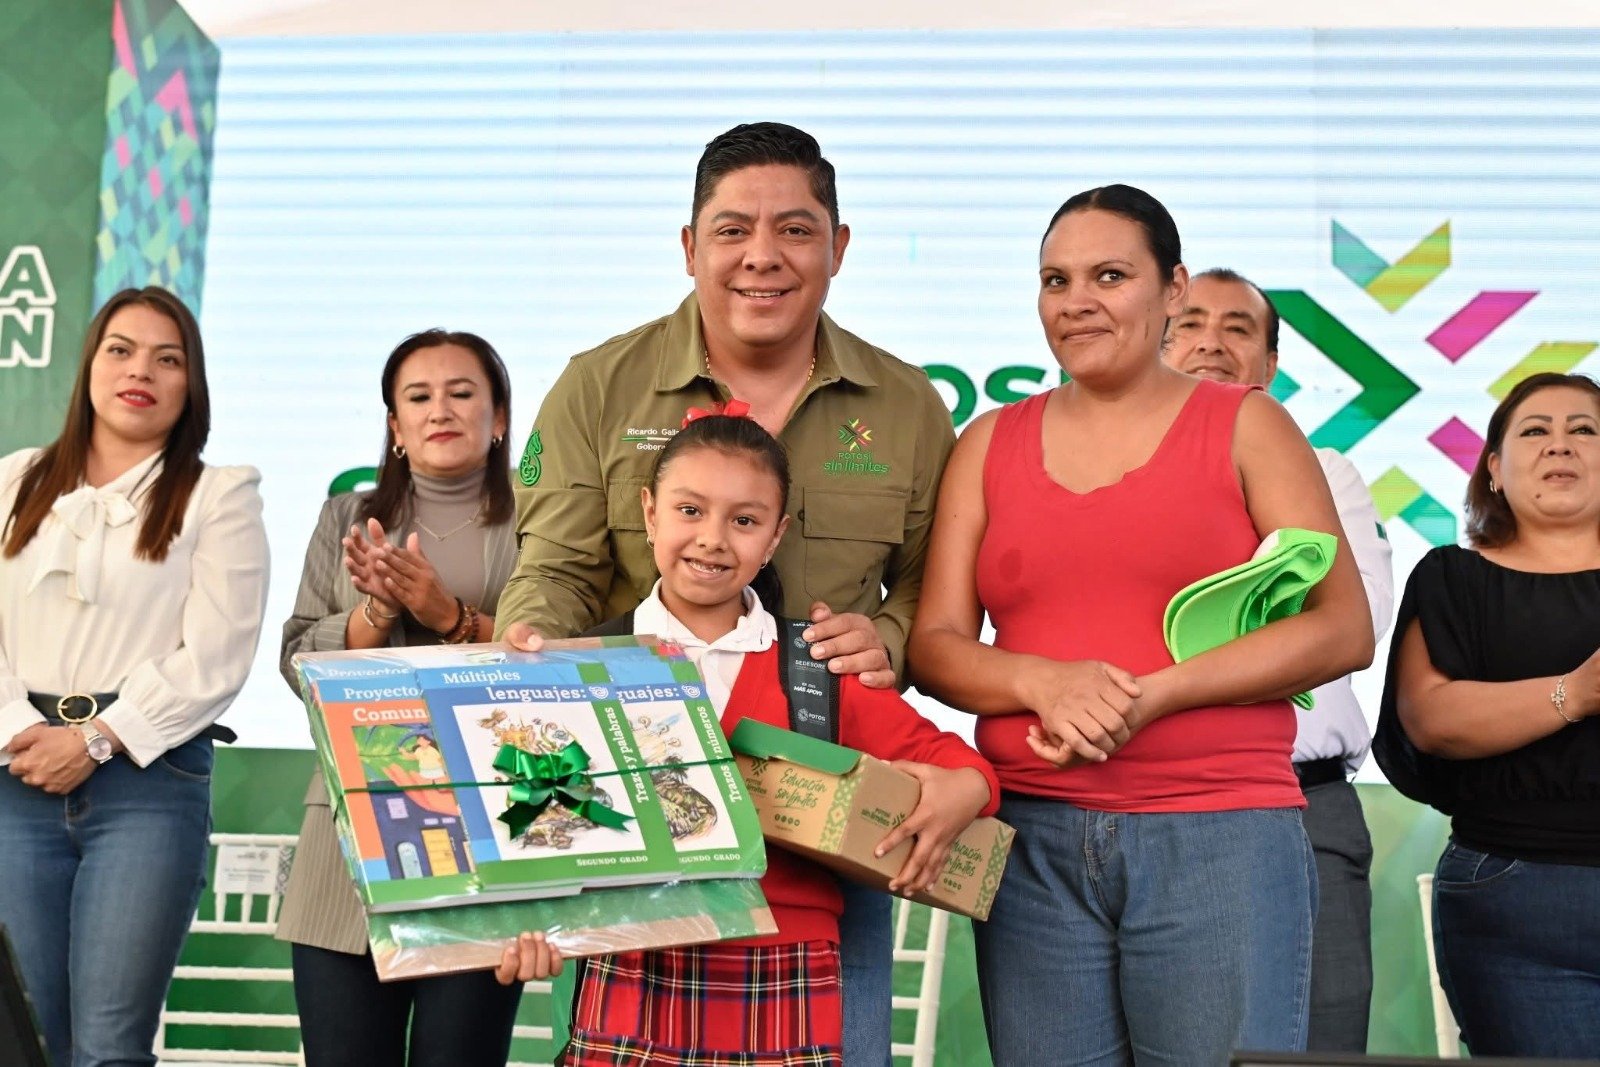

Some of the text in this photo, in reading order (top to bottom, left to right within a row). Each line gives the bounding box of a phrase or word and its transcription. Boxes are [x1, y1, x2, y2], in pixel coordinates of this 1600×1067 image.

[627, 428, 658, 436] Ricardo
[442, 667, 521, 685] Múltiples
[344, 686, 424, 702] Proyecto
[486, 686, 587, 702] lenguajes:
[353, 707, 428, 722] Comun
[605, 707, 634, 755] palabras
[697, 706, 723, 757] números
[720, 765, 742, 802] Trazos
